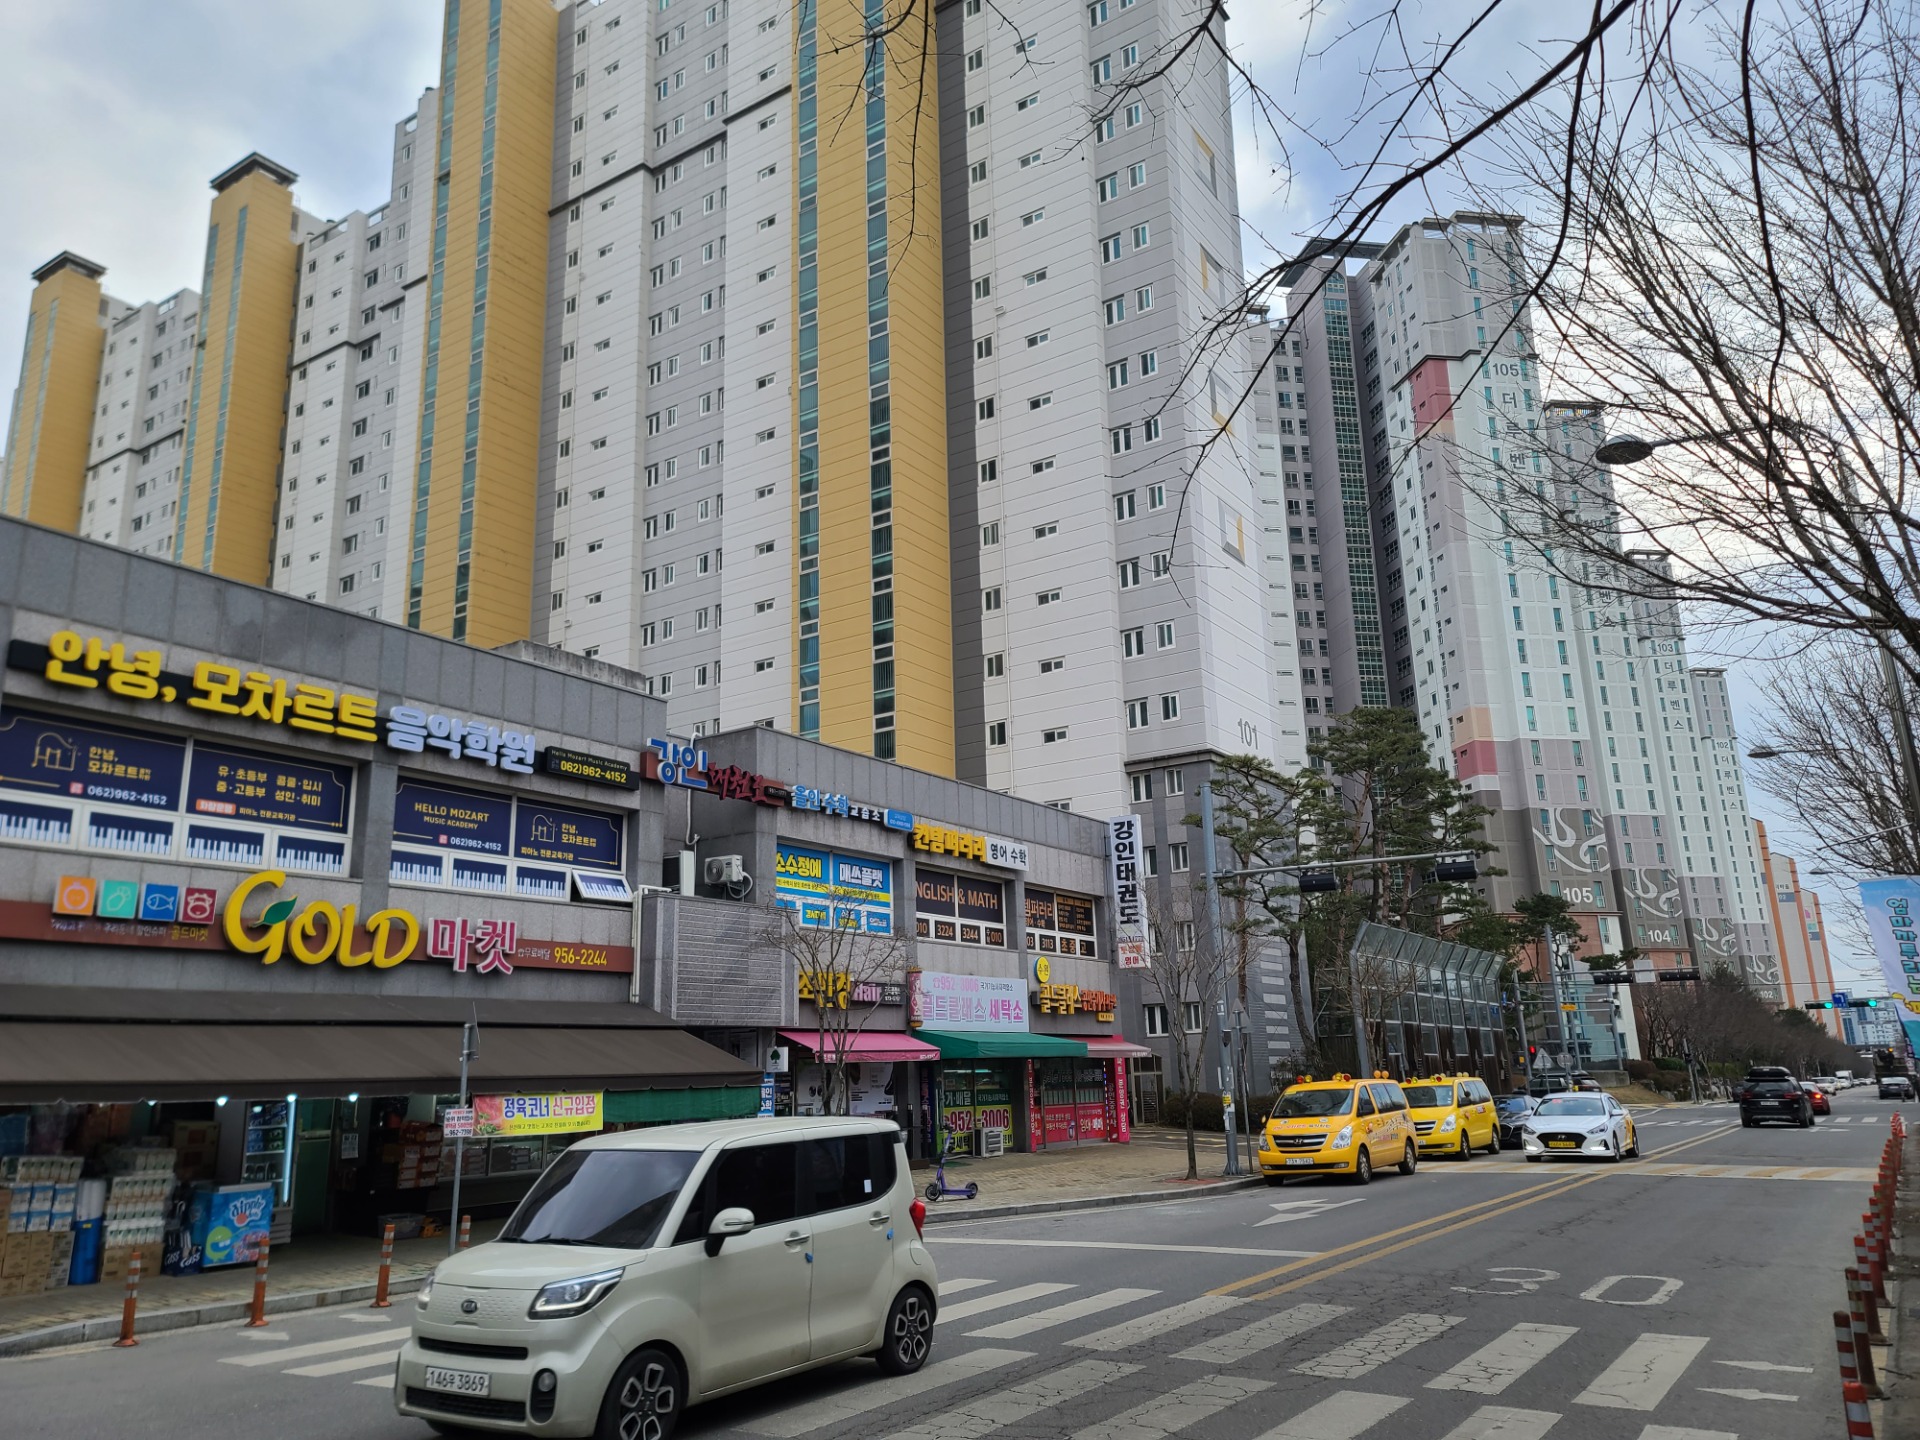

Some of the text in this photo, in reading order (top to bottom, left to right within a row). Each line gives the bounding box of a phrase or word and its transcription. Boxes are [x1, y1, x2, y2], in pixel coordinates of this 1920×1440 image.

[1492, 362, 1519, 377] 105
[1657, 644, 1673, 652] 103
[46, 630, 535, 774] 안녕, 모차르트 음악학원
[1237, 717, 1258, 750] 101
[88, 746, 118, 762] 안녕,
[1716, 741, 1729, 749] 102
[88, 759, 138, 779] 모차르트
[560, 760, 627, 783] 062)962-4152
[568, 752, 587, 761] Mozart
[604, 761, 628, 771] Academy
[647, 737, 708, 789] 강인
[87, 785, 167, 805] 062)962-4152
[791, 784, 821, 811] 올인
[824, 792, 850, 818] 수학
[851, 806, 882, 822] 교습소
[414, 802, 490, 823] HELLO MOZART
[423, 815, 479, 830] MUSIC ACADEMY
[450, 836, 502, 851] 062)962-4152
[561, 834, 589, 845] 모차르트
[990, 843, 1008, 862] 영어
[1010, 848, 1027, 866] 수학
[1113, 820, 1140, 927] 강인태권도
[957, 888, 965, 905] &
[968, 890, 998, 910] MATH
[1564, 887, 1593, 904] 105
[223, 870, 420, 968] GOLD
[937, 924, 953, 937] 3224
[962, 927, 979, 940] 3244
[1648, 929, 1671, 943] 104
[427, 917, 517, 975] 마켓
[554, 946, 607, 966] 956-2244
[1125, 956, 1139, 965] 영어
[989, 999, 1024, 1023] 세탁소
[504, 1095, 596, 1119] 정육코너 신규입점
[457, 1374, 485, 1393] 3869
